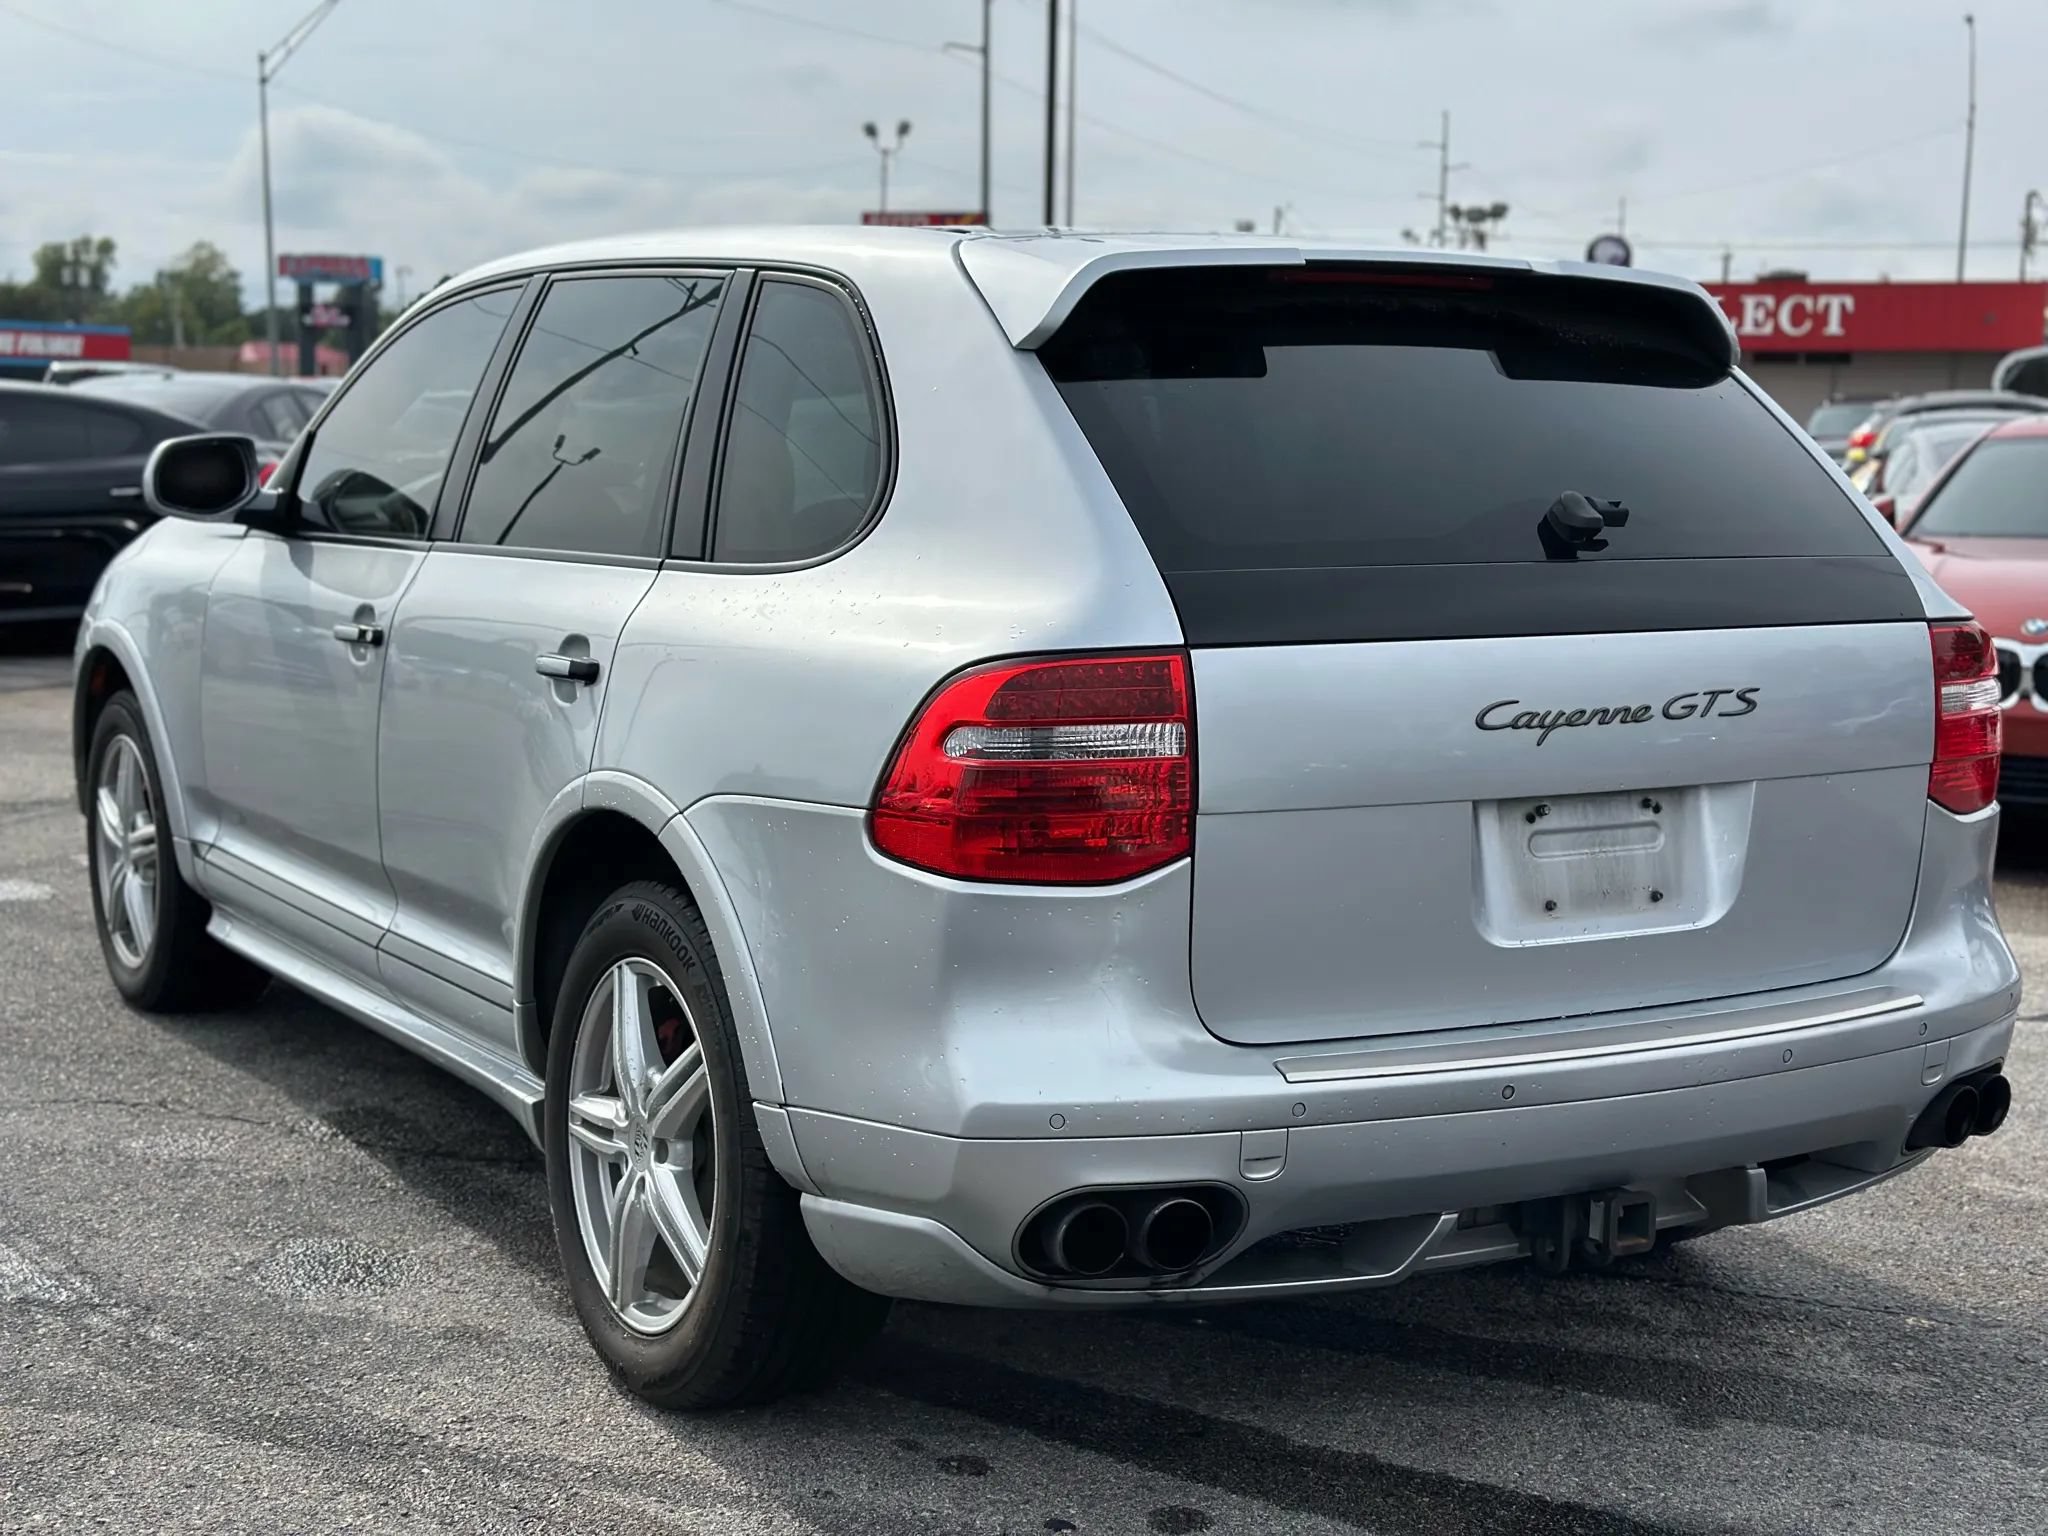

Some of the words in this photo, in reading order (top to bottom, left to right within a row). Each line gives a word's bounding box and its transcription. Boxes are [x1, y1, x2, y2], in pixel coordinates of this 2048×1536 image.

[1712, 293, 1855, 337] ECT
[1475, 699, 1655, 747] Cayenne
[1661, 687, 1761, 721] GTS
